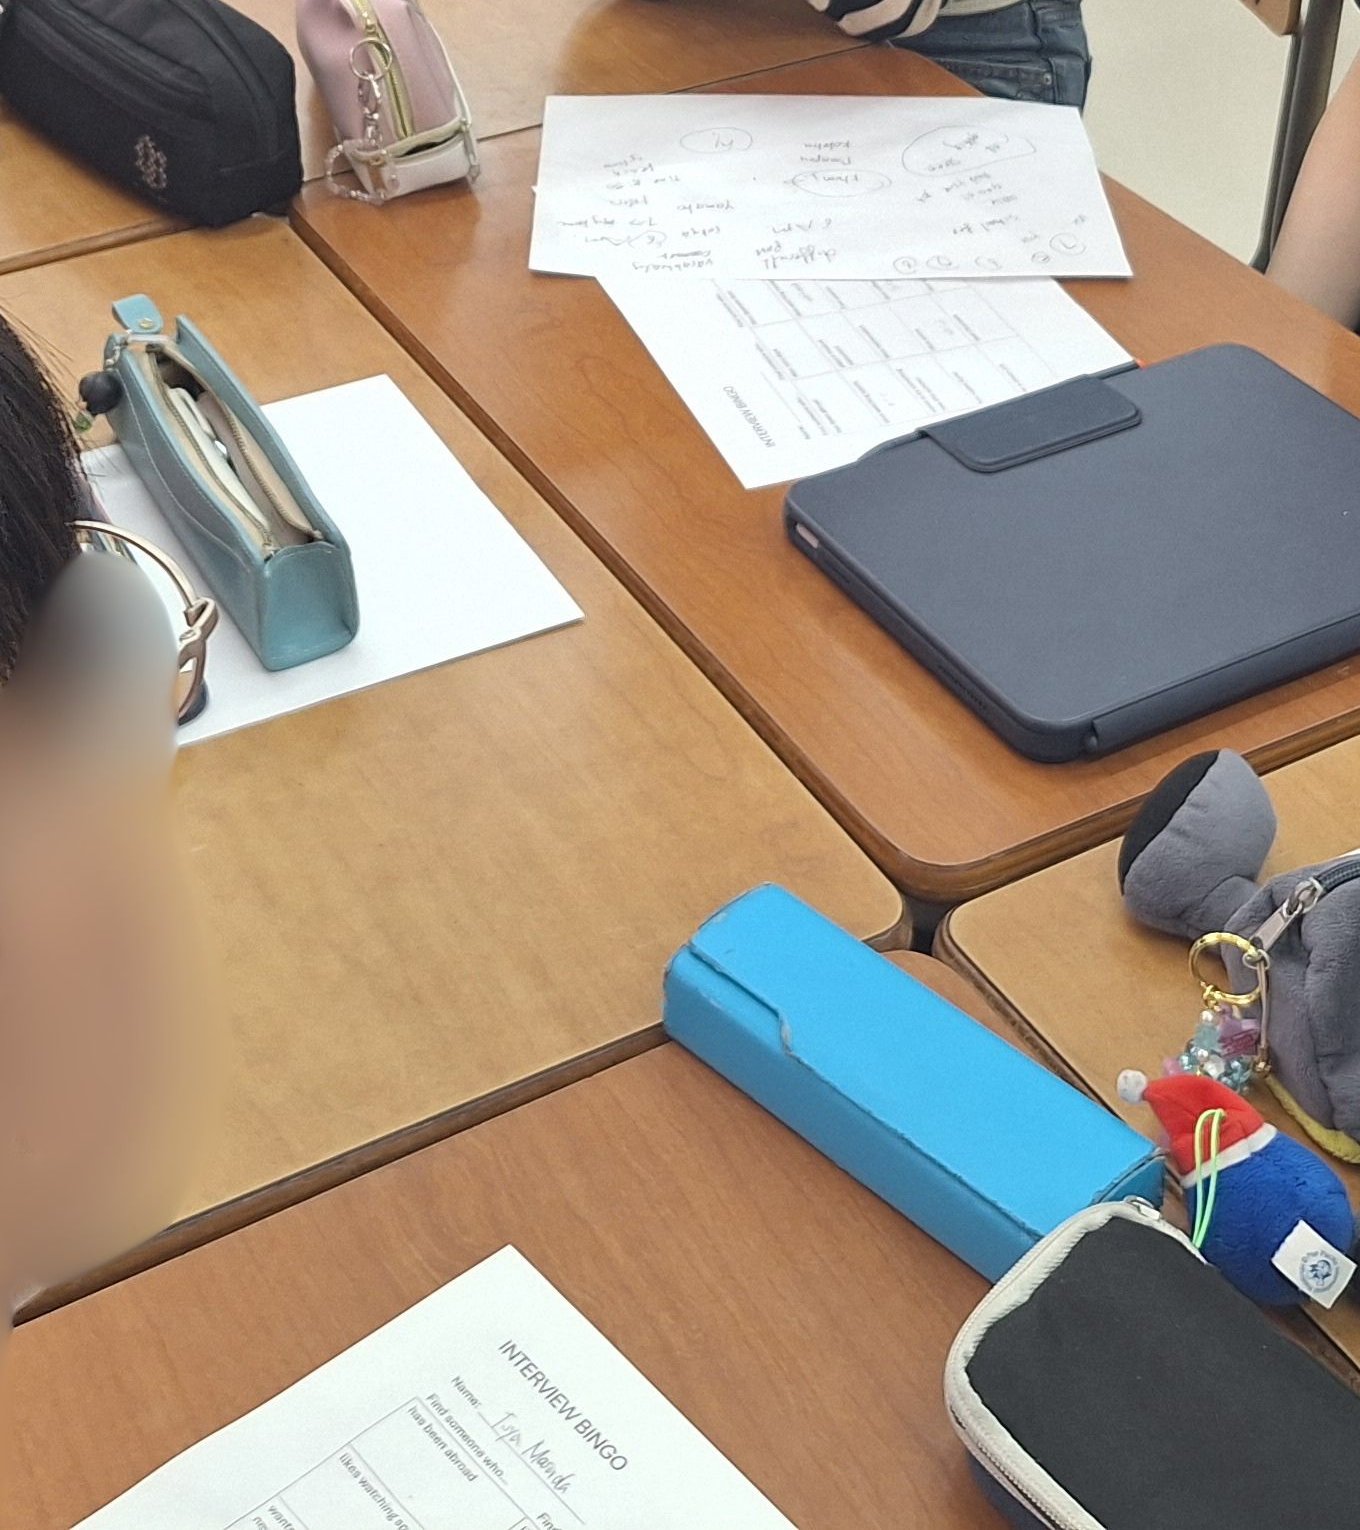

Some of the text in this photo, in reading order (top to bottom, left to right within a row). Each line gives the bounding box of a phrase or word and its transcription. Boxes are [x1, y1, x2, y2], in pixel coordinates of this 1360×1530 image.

[450, 1375, 482, 1409] Name:
[497, 1339, 628, 1471] INTERVIEW BINGO
[407, 1405, 479, 1483] has been abroad
[426, 1392, 508, 1485] Find someone who...
[339, 1452, 398, 1522] likes watching
[536, 1512, 562, 1530] Fin
